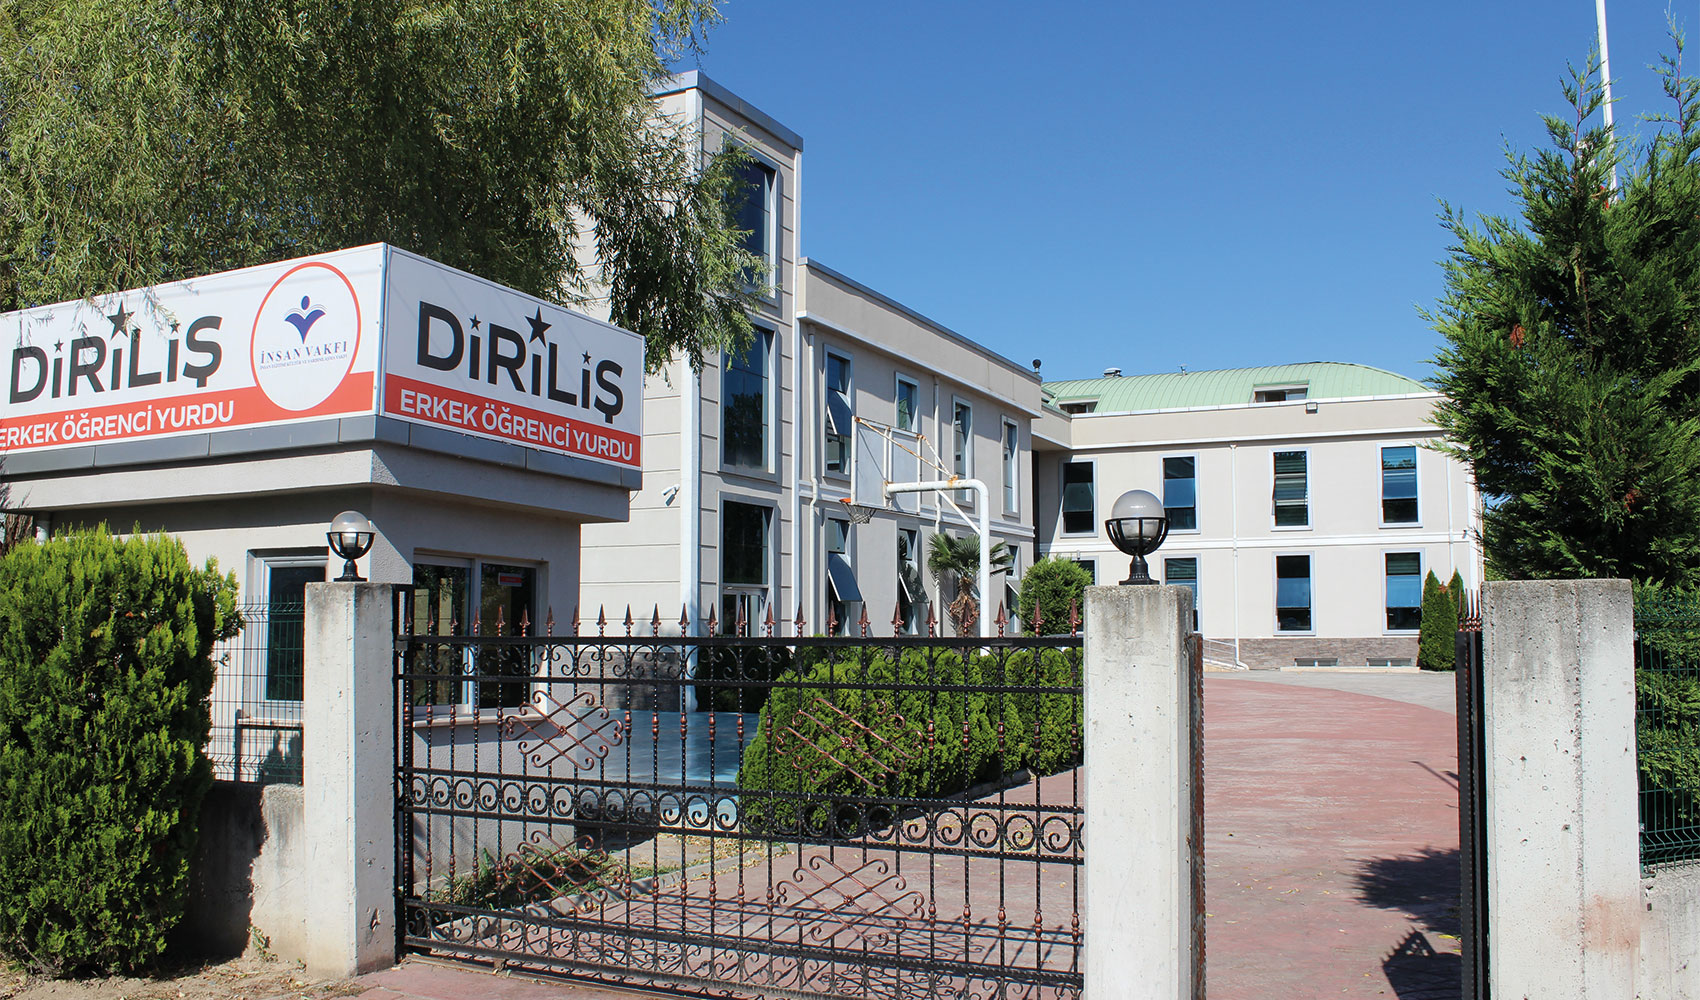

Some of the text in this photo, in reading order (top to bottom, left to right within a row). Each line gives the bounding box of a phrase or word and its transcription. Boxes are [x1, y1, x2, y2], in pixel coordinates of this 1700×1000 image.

[261, 348, 302, 364] İNSAN
[306, 341, 347, 356] VAKFI
[0, 400, 235, 447] ERKEK ÖĞRENCİ YURDU
[400, 389, 633, 461] ERKEK ÖĞRENCİ YURDU
